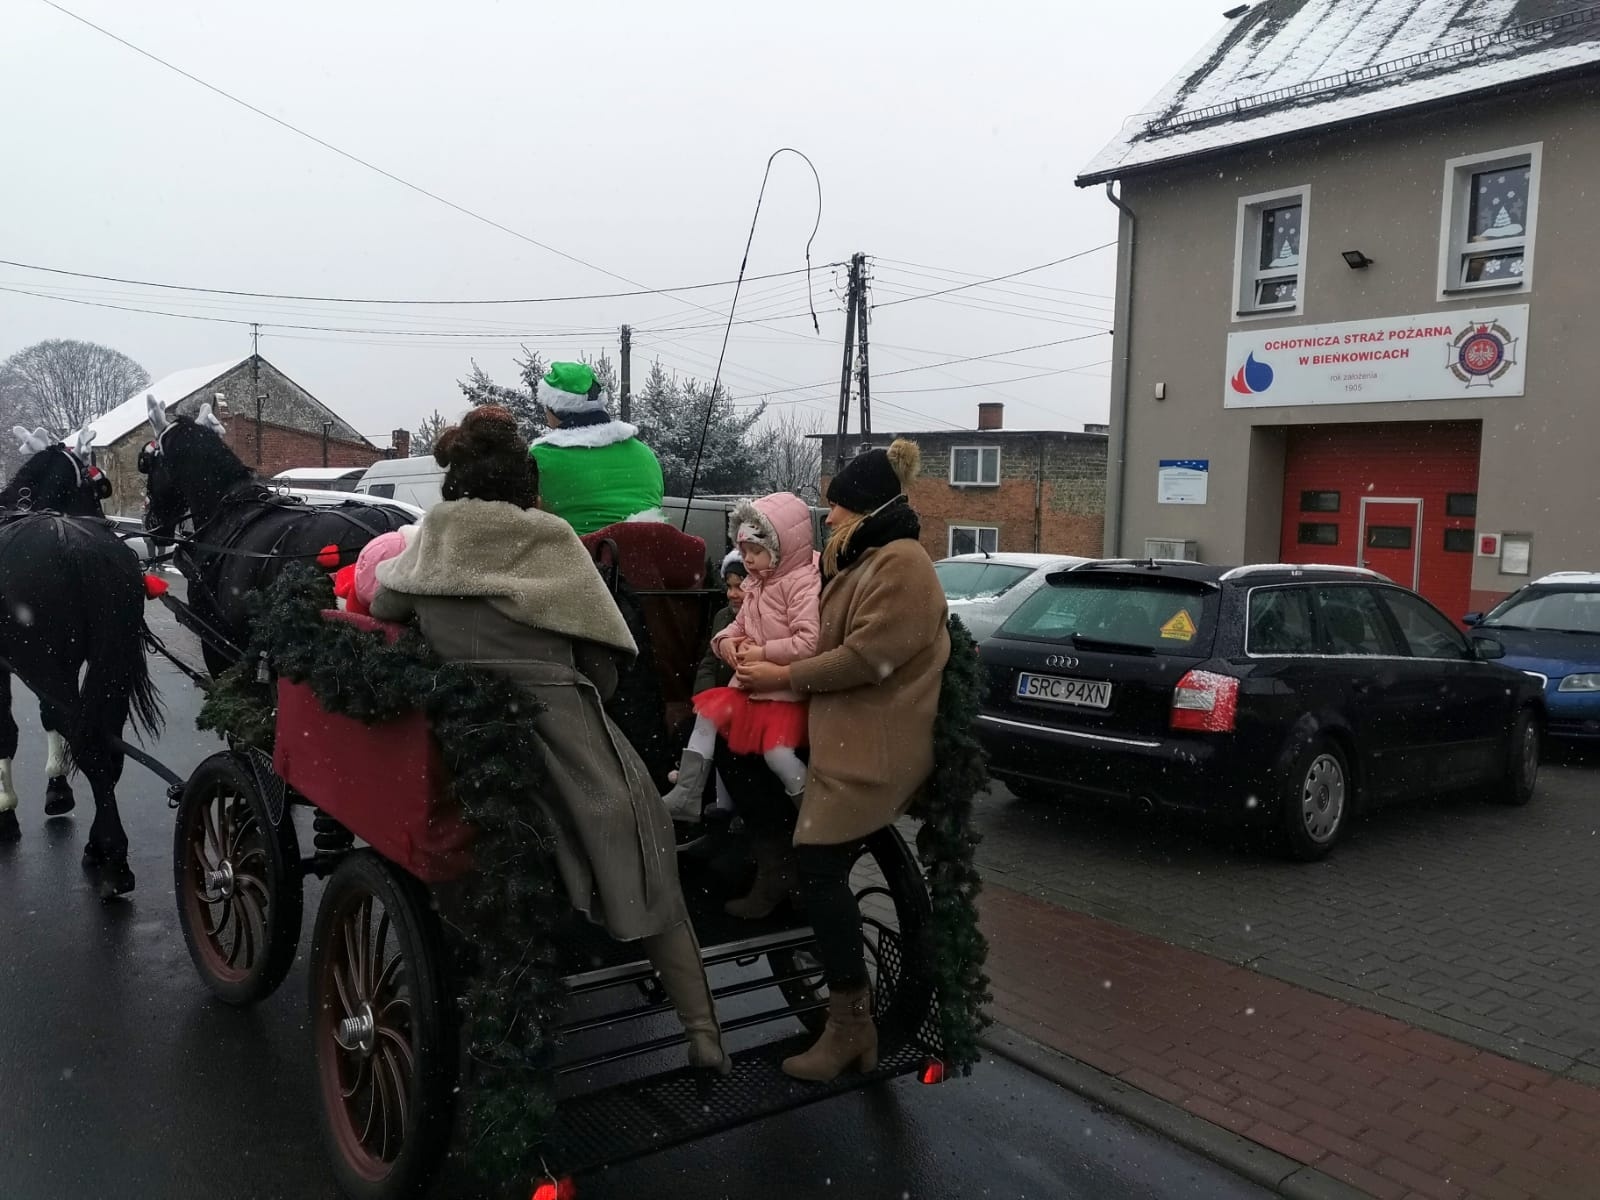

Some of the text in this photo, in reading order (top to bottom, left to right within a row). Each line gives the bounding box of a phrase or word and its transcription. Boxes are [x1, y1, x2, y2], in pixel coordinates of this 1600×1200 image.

[1264, 326, 1453, 351] OCHOTNICZA STRAŻ POŻARNA
[1299, 348, 1409, 366] W BIEŃKOWICACH
[1028, 677, 1107, 704] SRC 94XN
